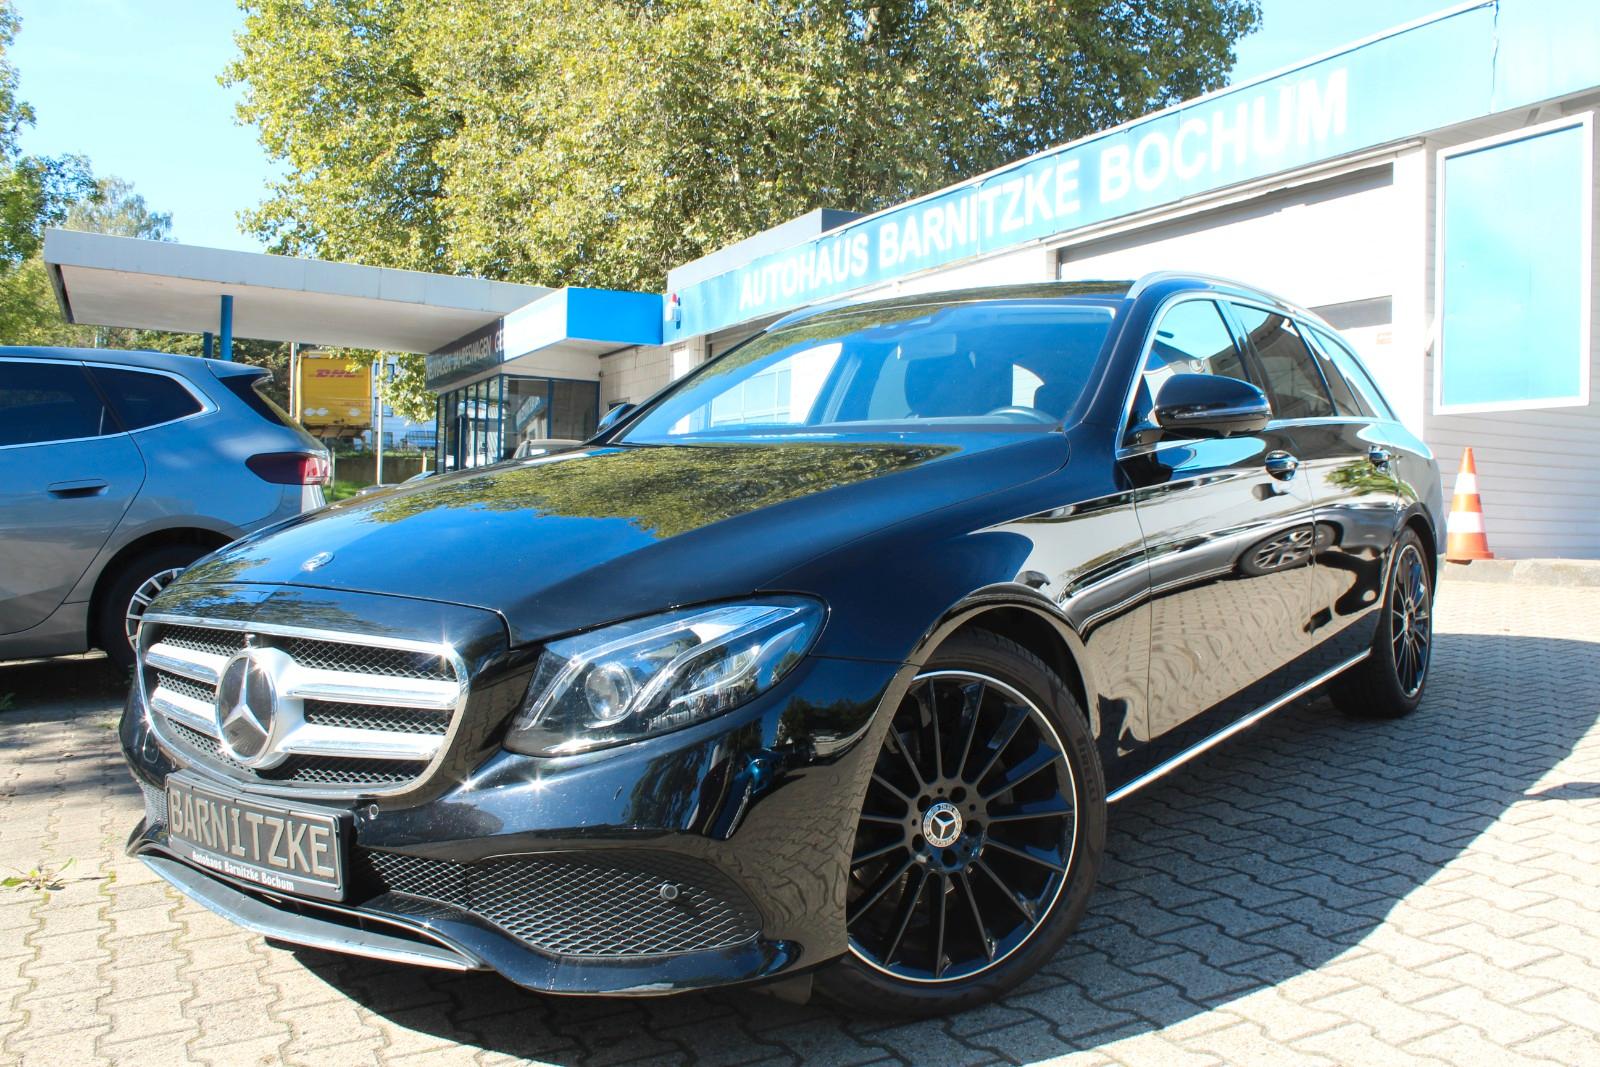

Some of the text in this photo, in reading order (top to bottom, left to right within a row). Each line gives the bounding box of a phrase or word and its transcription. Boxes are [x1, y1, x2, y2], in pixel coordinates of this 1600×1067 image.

[739, 68, 1348, 311] AUTOHAUS BARNITZKE BOCHUM
[169, 789, 335, 878] BARNITZKE
[192, 850, 295, 892] Autohaus Barnitzke Bochum
